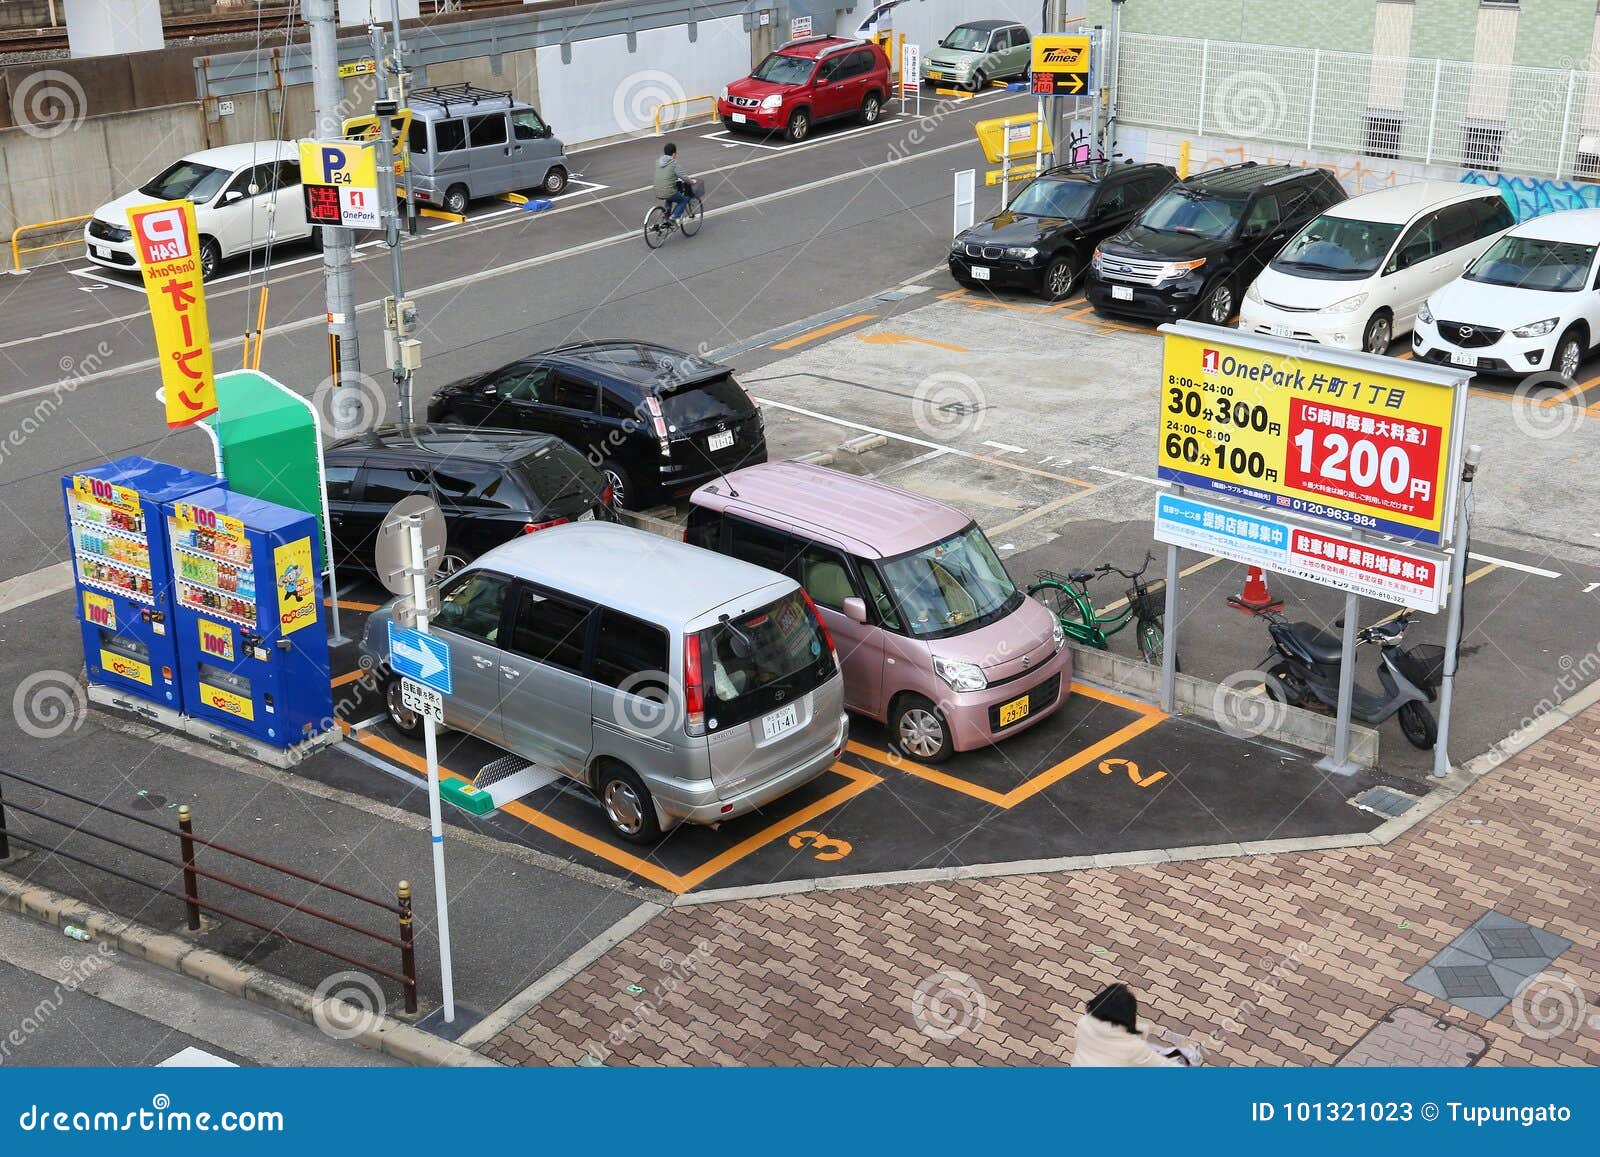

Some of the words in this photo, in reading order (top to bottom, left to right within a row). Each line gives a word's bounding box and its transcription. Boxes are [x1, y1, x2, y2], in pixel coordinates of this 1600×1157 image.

[1042, 48, 1083, 63] Times
[321, 147, 346, 184] P
[333, 172, 352, 184] 24
[311, 187, 340, 219] 満
[342, 210, 375, 220] OnePark
[1221, 356, 1306, 390] OnePark
[1294, 427, 1431, 502] 1200円
[88, 478, 113, 500] 100
[191, 505, 217, 529] 100
[1293, 500, 1377, 529] 0120-963-984
[88, 603, 109, 626] 100
[203, 631, 224, 655] 100
[404, 693, 442, 720] ここまで
[1006, 704, 1028, 722] 29-70
[772, 713, 795, 735] 11-41
[1099, 758, 1167, 788] 2
[788, 830, 853, 861] 3
